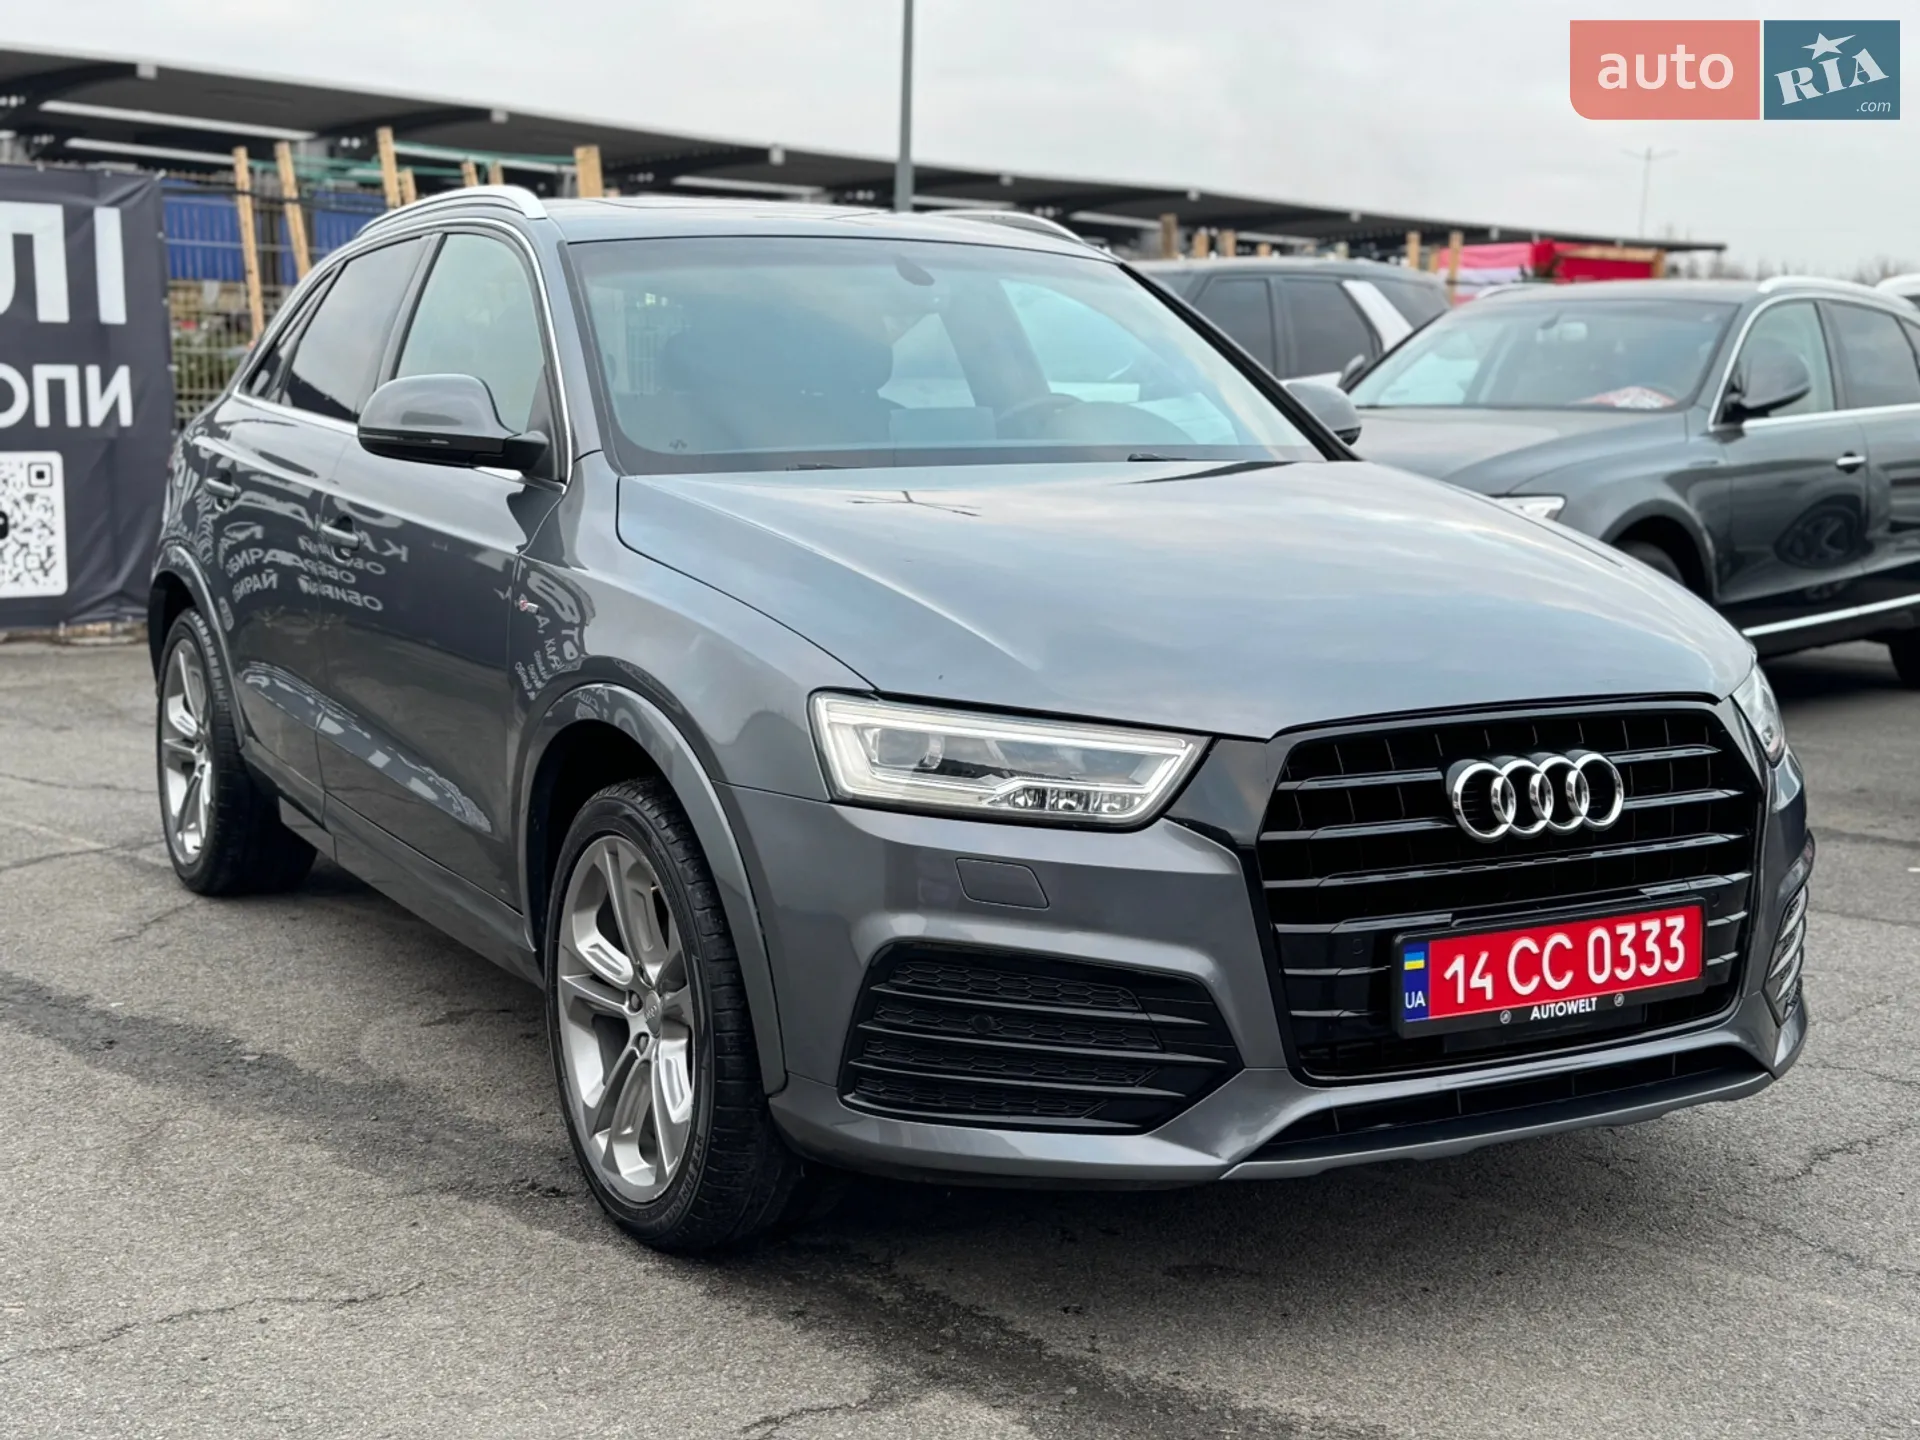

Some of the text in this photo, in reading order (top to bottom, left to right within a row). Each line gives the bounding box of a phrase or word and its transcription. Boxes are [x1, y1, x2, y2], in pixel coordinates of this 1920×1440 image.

[1444, 915, 1685, 1004] 14 CC 0333
[1405, 991, 1426, 1009] UA
[1530, 997, 1597, 1020] AUTOWELT
